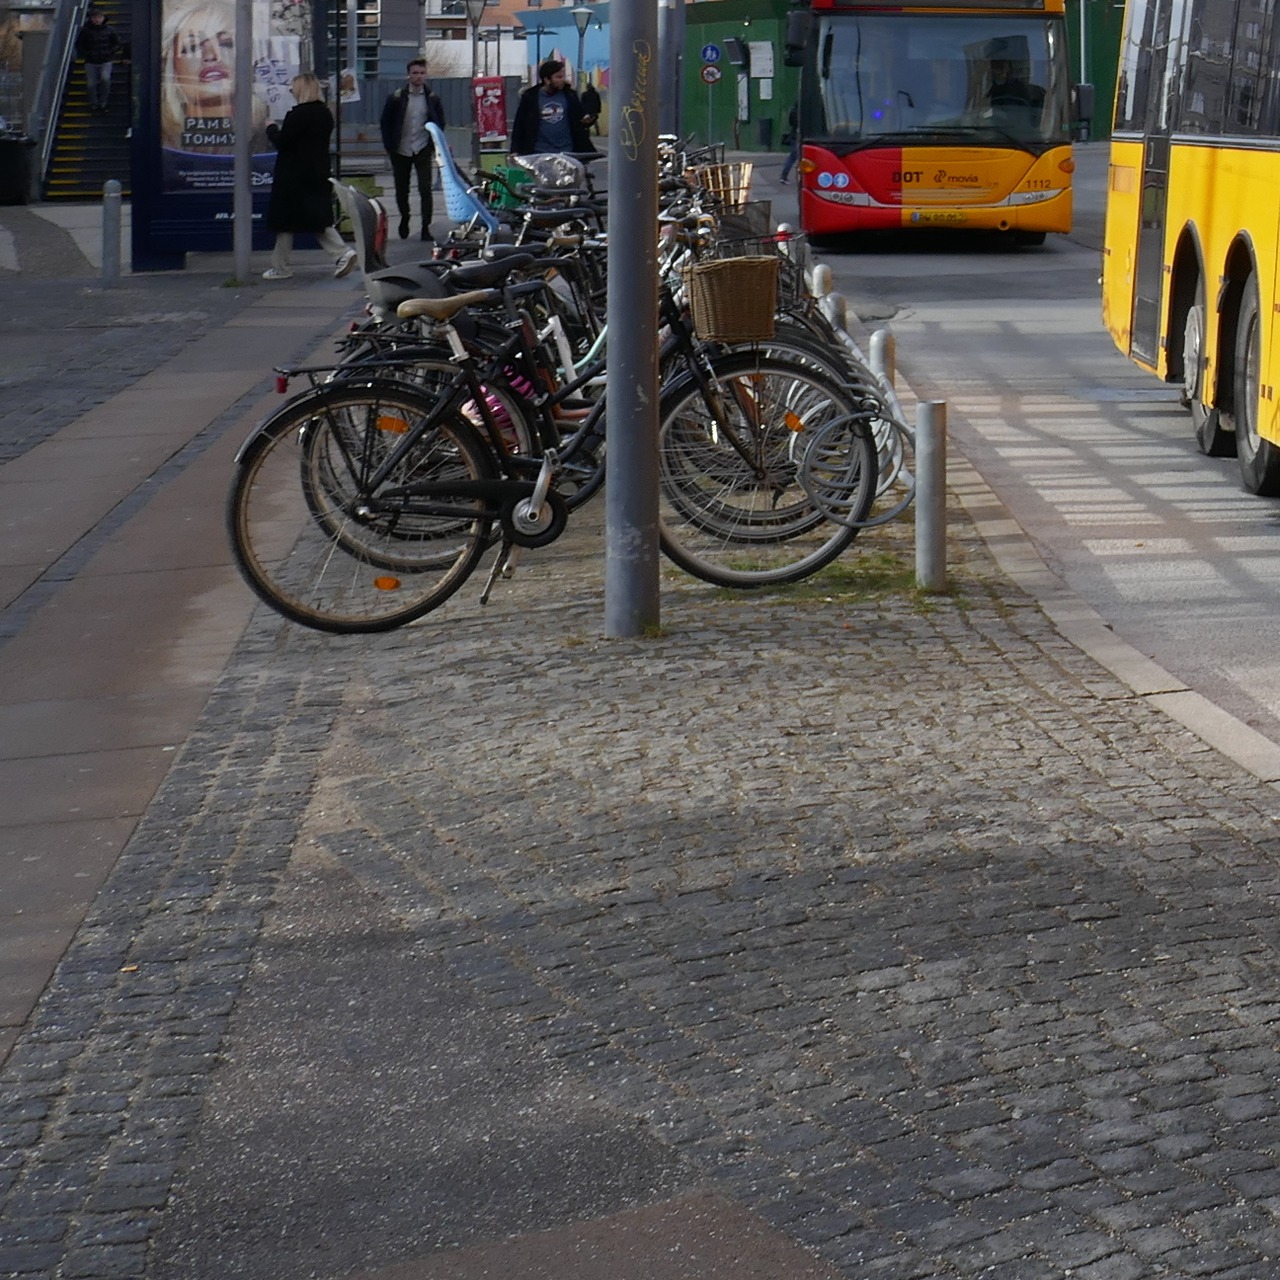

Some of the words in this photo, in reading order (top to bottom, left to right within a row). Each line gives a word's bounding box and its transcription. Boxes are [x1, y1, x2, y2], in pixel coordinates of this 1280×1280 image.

[186, 118, 219, 129] PAM
[183, 132, 236, 145] TOMMY
[892, 171, 923, 184] DOT
[947, 175, 979, 184] movia
[1026, 179, 1051, 189] 1112
